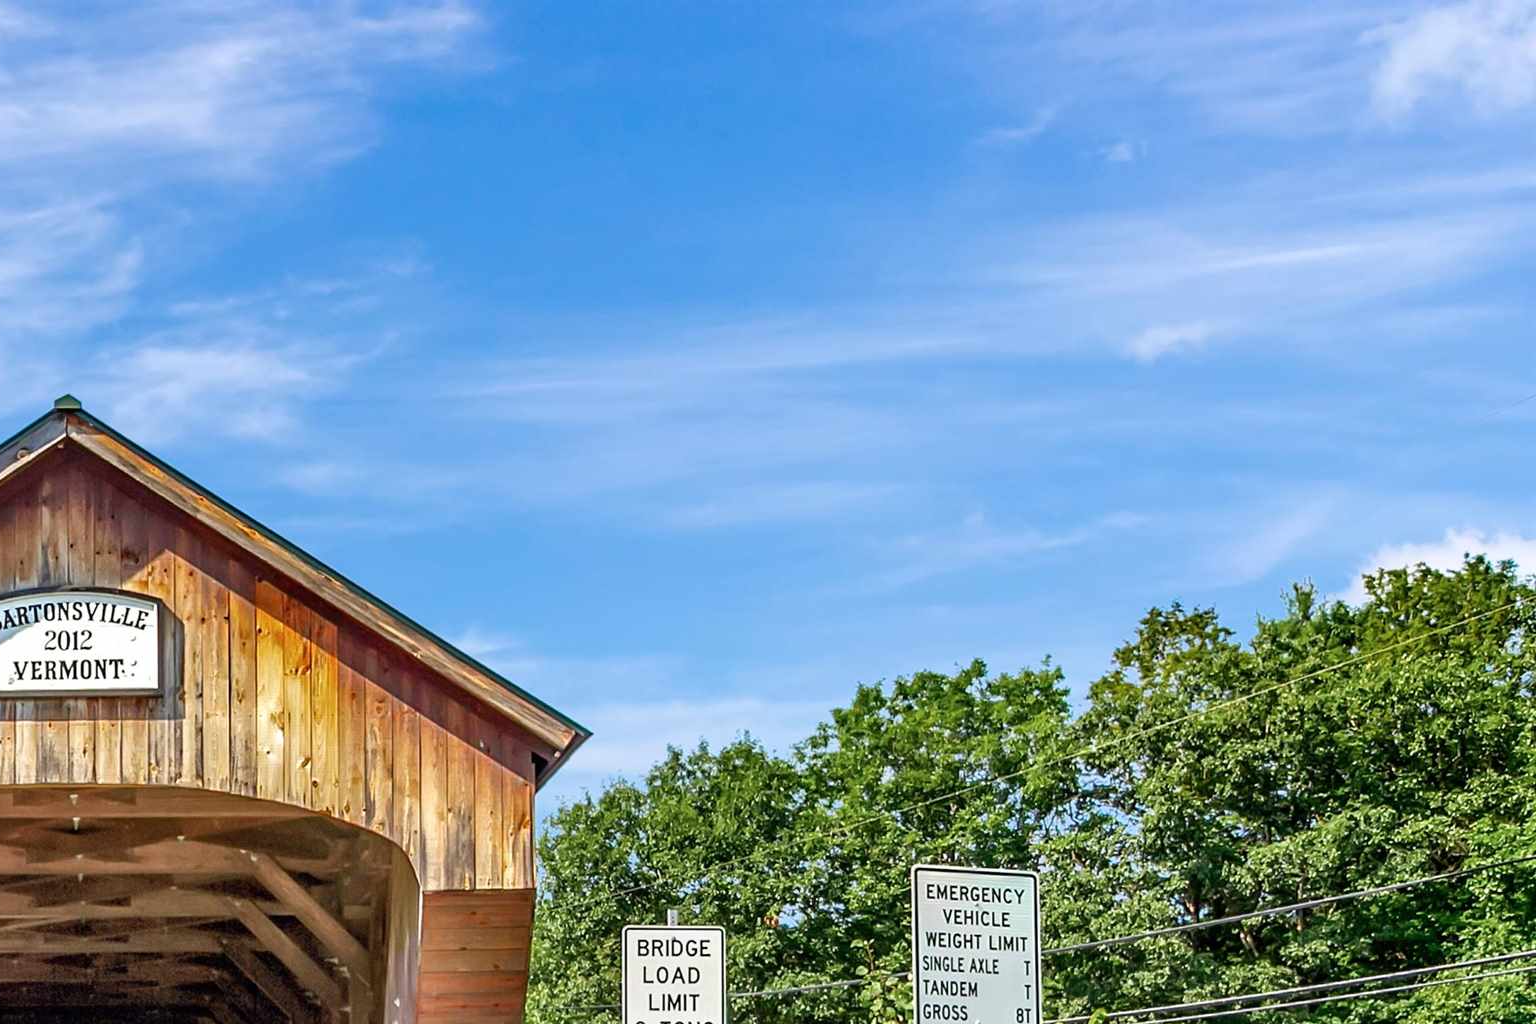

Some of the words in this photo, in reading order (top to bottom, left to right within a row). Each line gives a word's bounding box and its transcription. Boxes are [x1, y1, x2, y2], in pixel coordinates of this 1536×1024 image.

[44, 629, 93, 650] 2012
[14, 659, 124, 680] VERMONT
[926, 884, 1025, 904] EMERGENCY
[942, 909, 1011, 927] VEHICLE
[637, 939, 711, 957] BRIDGE
[925, 931, 982, 950] WEIGHT
[988, 935, 1028, 952] LIMIT
[642, 966, 700, 984] LOAD
[923, 955, 965, 973] SINGLE
[969, 958, 1000, 975] AXLE
[1024, 960, 1031, 976] T
[923, 979, 978, 997] TANDEM
[1024, 984, 1032, 1000] T
[648, 994, 700, 1011] LIMIT
[923, 1004, 968, 1021] GROSS
[1016, 1008, 1032, 1024] 8T
